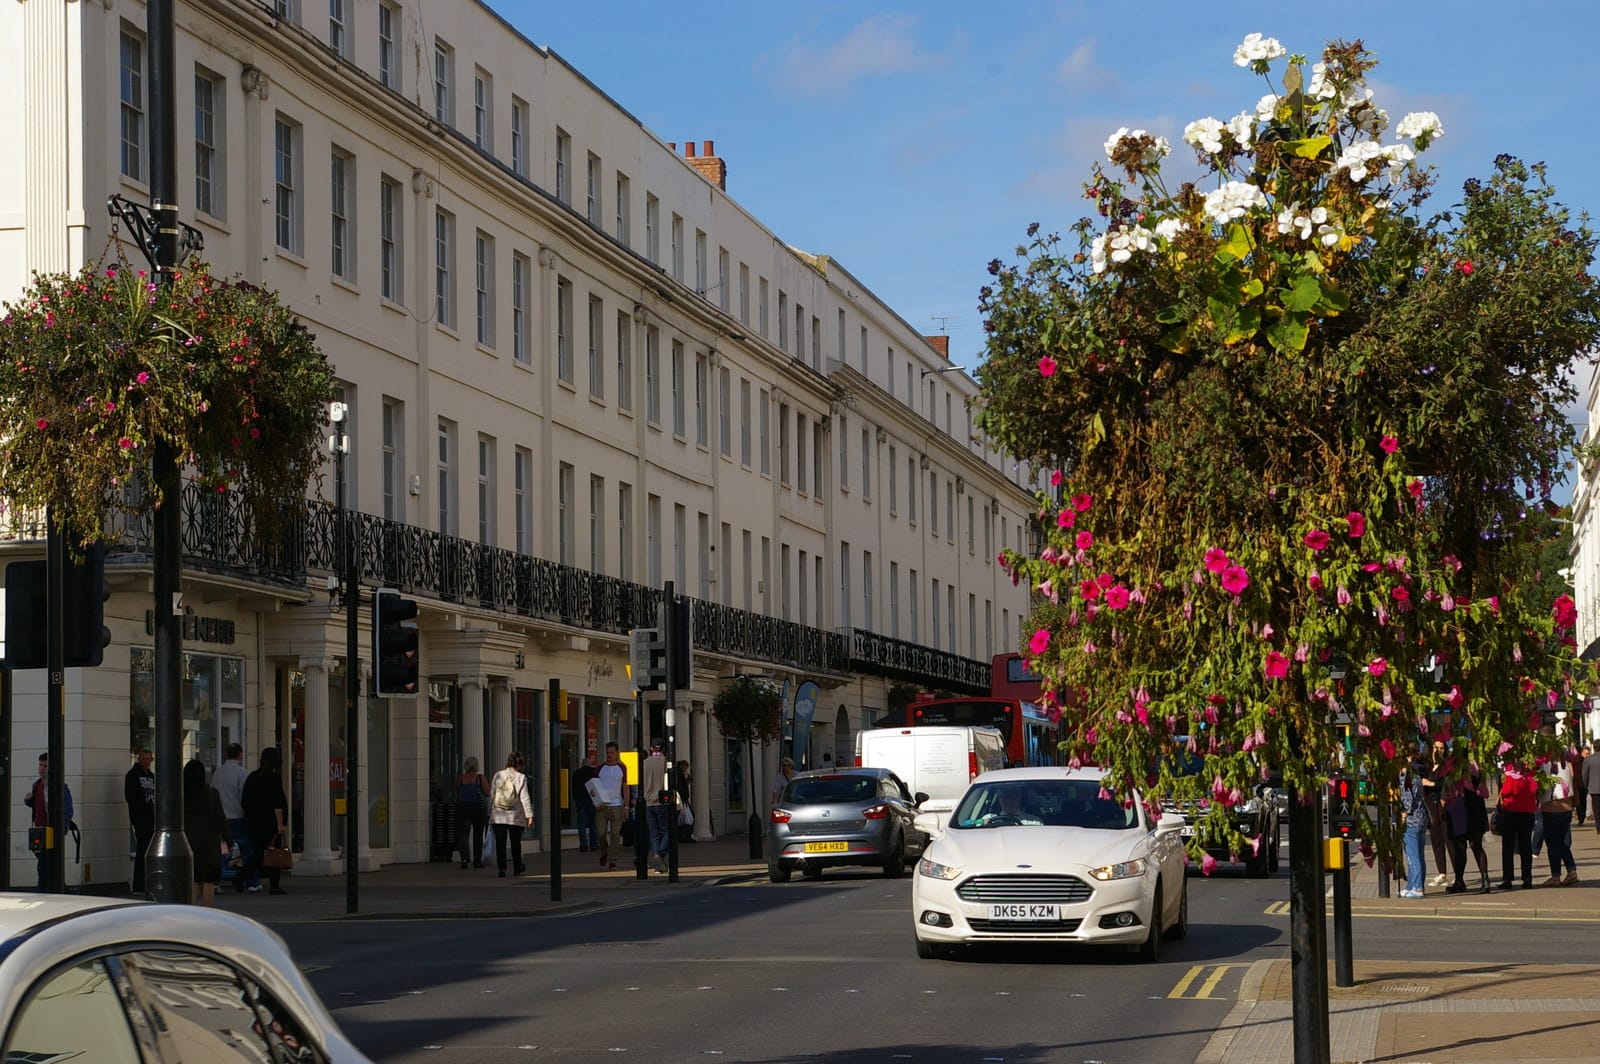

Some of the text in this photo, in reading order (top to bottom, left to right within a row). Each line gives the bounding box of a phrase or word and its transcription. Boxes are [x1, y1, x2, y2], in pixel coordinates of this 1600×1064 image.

[330, 762, 345, 781] SAL
[809, 842, 828, 851] VE64
[994, 905, 1055, 917] DK65 KZM
